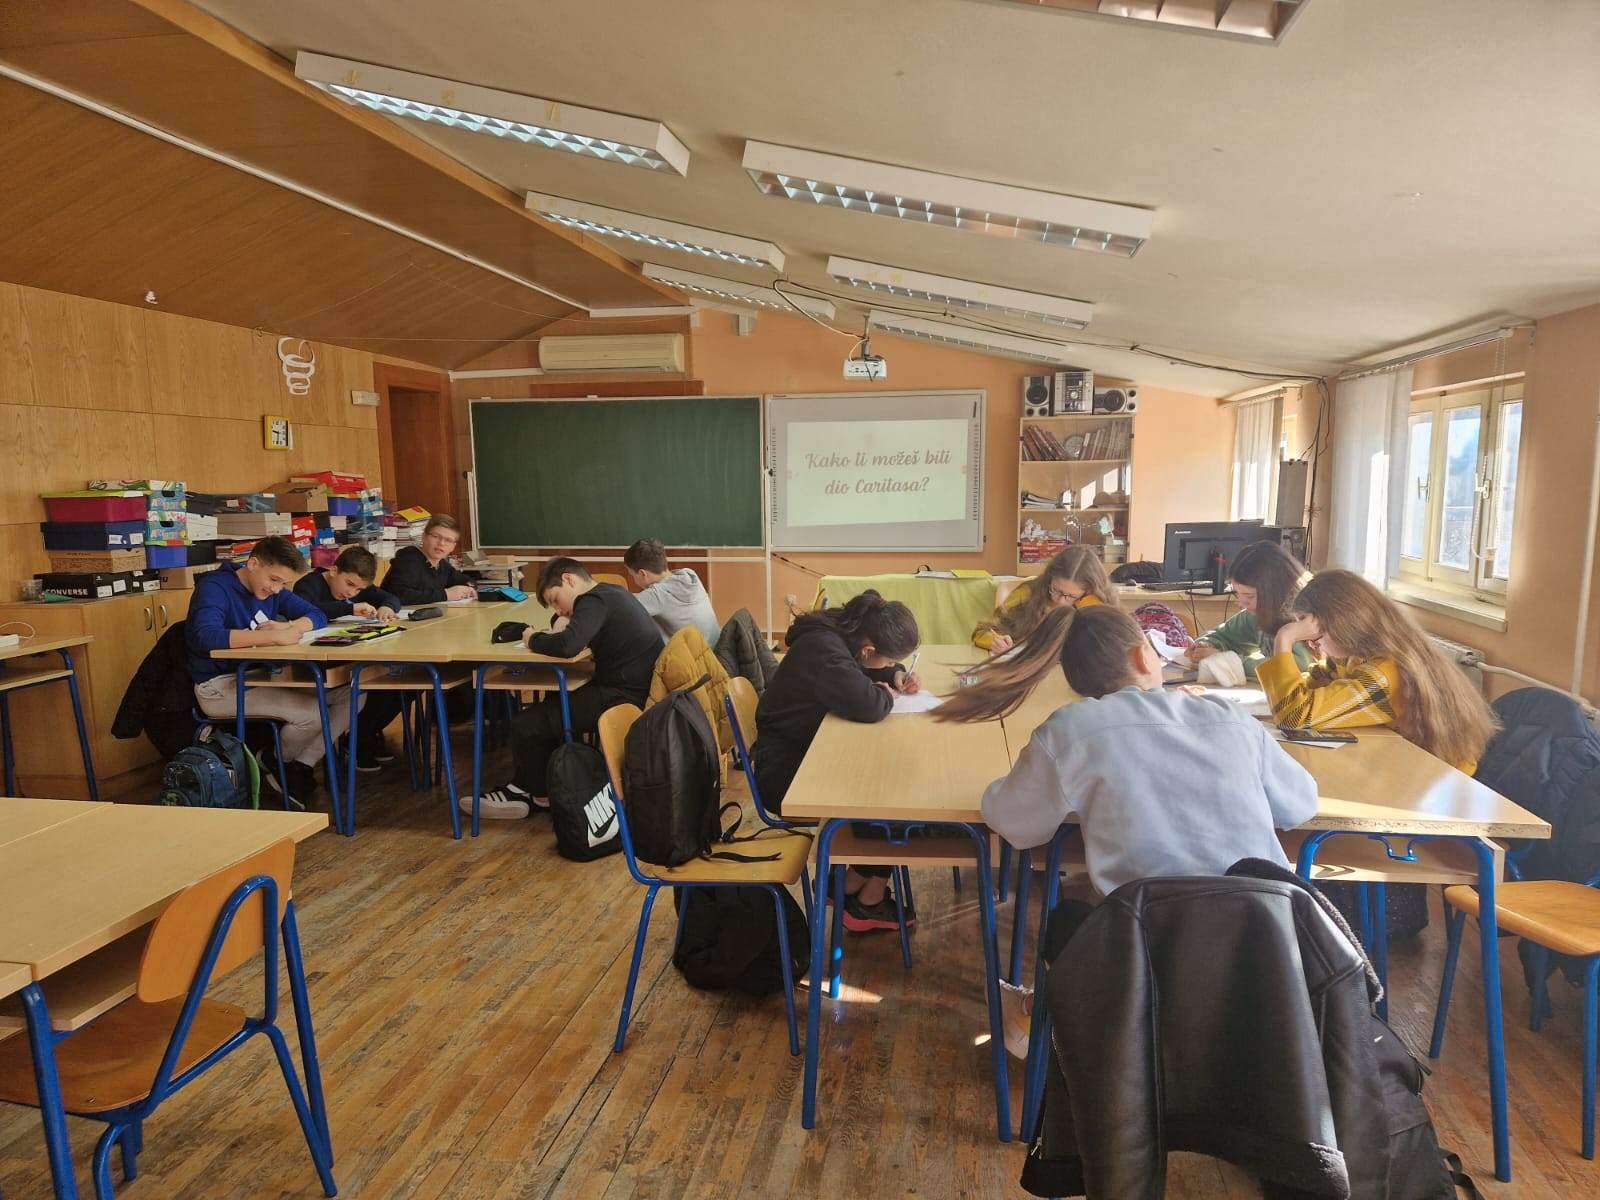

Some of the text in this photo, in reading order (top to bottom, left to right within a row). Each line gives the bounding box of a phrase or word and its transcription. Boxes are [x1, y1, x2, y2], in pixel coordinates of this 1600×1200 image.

[805, 452, 851, 470] Kako
[872, 449, 920, 467] možeš
[825, 480, 851, 495] dio
